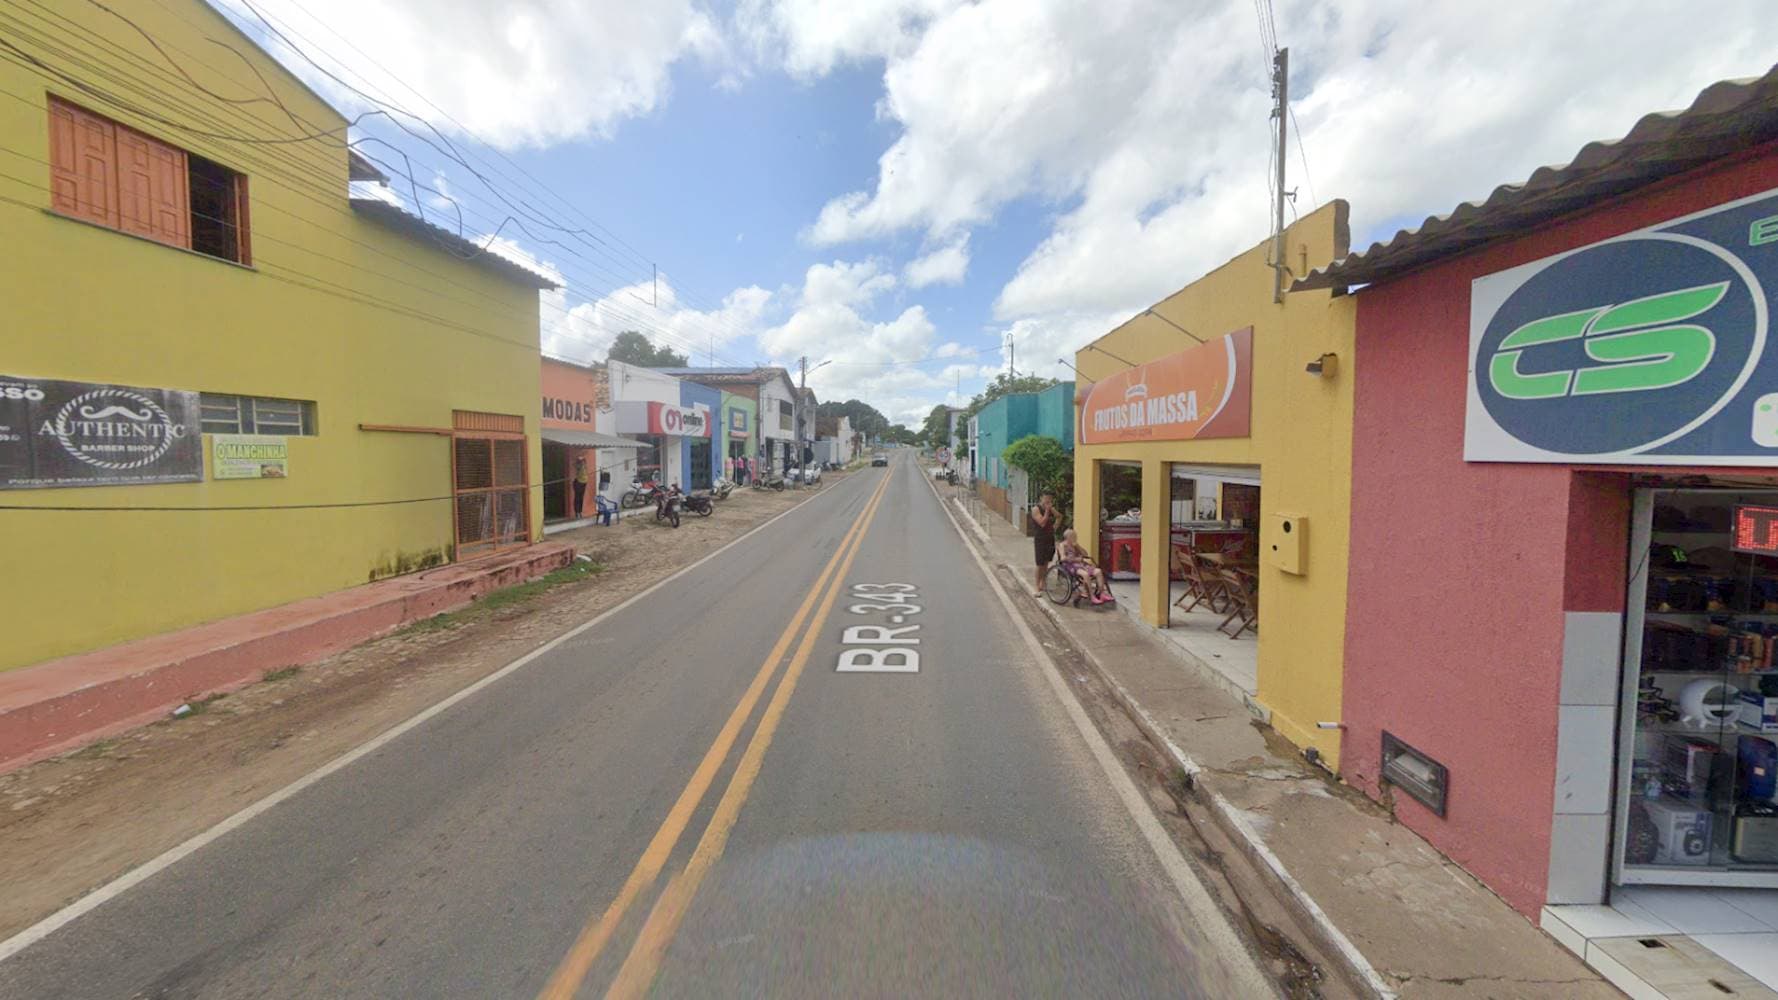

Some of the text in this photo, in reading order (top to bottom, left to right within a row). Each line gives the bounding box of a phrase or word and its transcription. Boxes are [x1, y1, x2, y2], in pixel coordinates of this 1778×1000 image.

[542, 396, 591, 423] MODAS
[1094, 390, 1198, 432] FRUTOS DA MASSA
[38, 419, 186, 438] AUTHENTIC
[81, 444, 155, 452] BARBER SHOP
[215, 443, 287, 460] O MANCHINHA
